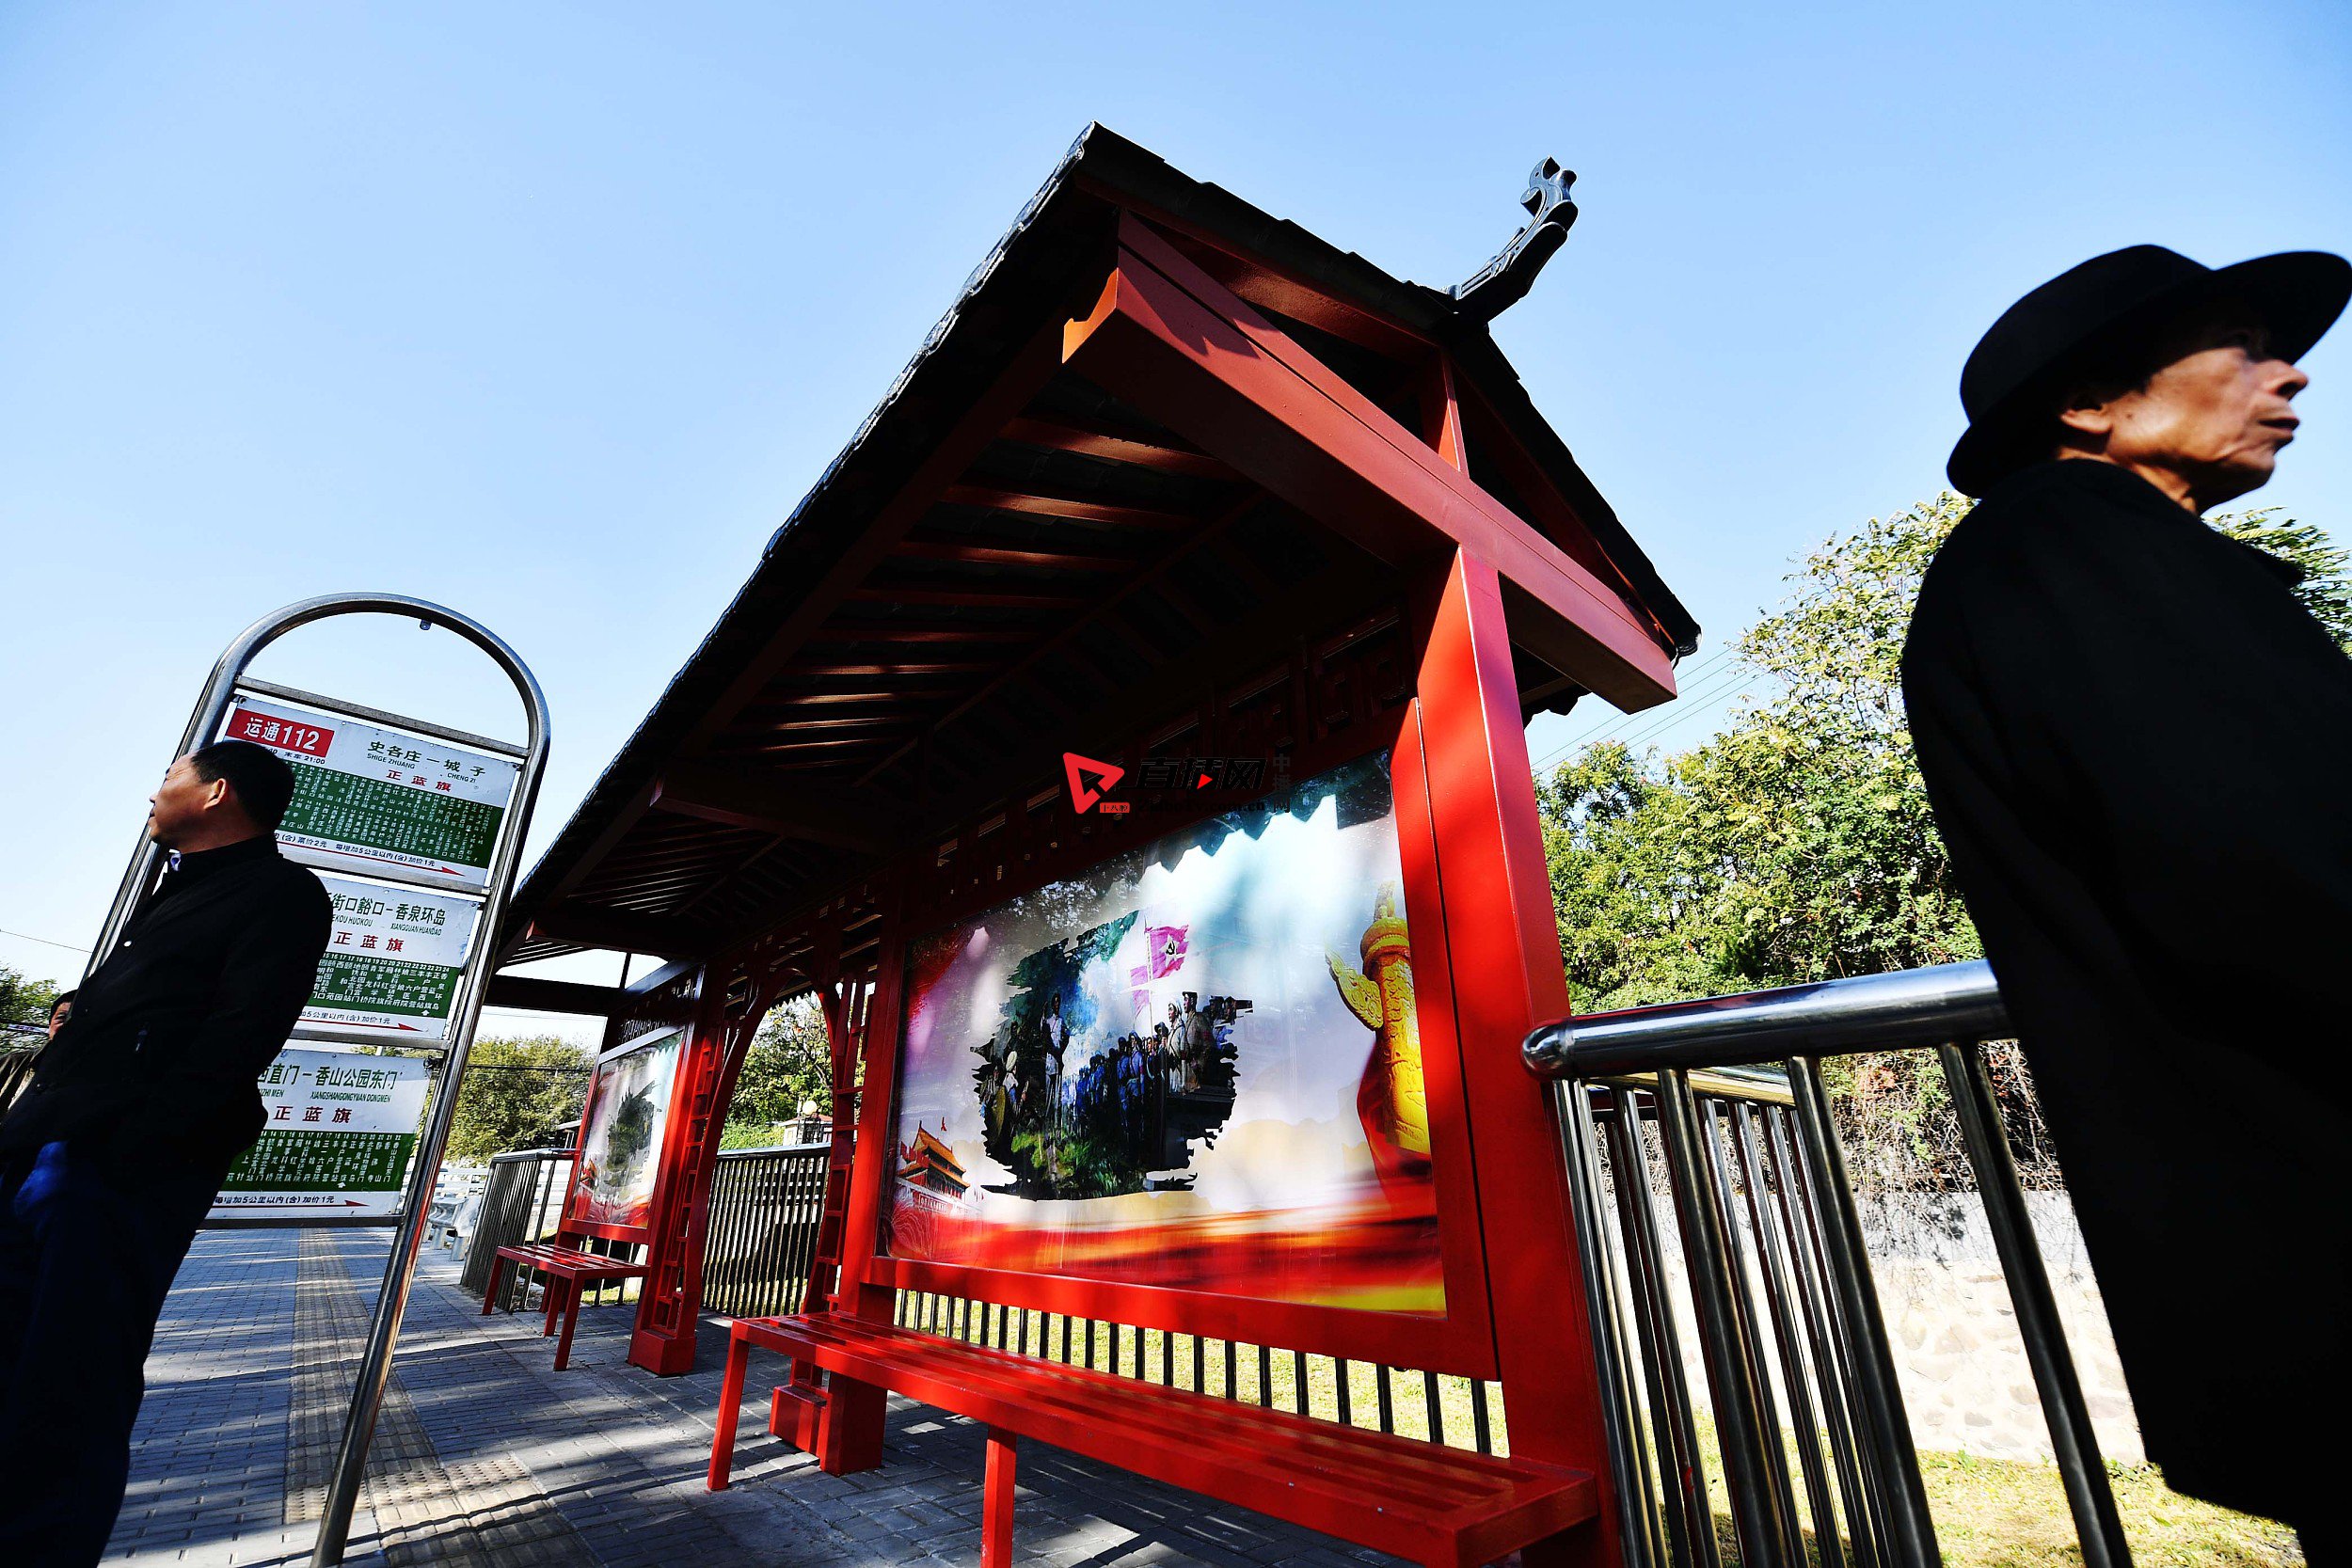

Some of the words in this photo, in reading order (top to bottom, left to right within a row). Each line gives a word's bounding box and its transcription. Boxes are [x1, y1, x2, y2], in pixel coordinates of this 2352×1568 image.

[244, 717, 320, 751] 运通112
[304, 755, 326, 766] 21:00
[367, 752, 387, 763] SHIGE
[388, 759, 415, 769] ZHUANG
[447, 772, 469, 783] CHENG
[330, 893, 446, 927] 街口豁口-香泉环岛
[333, 930, 405, 953] 正蓝旗
[273, 1105, 353, 1124] 正蓝旗
